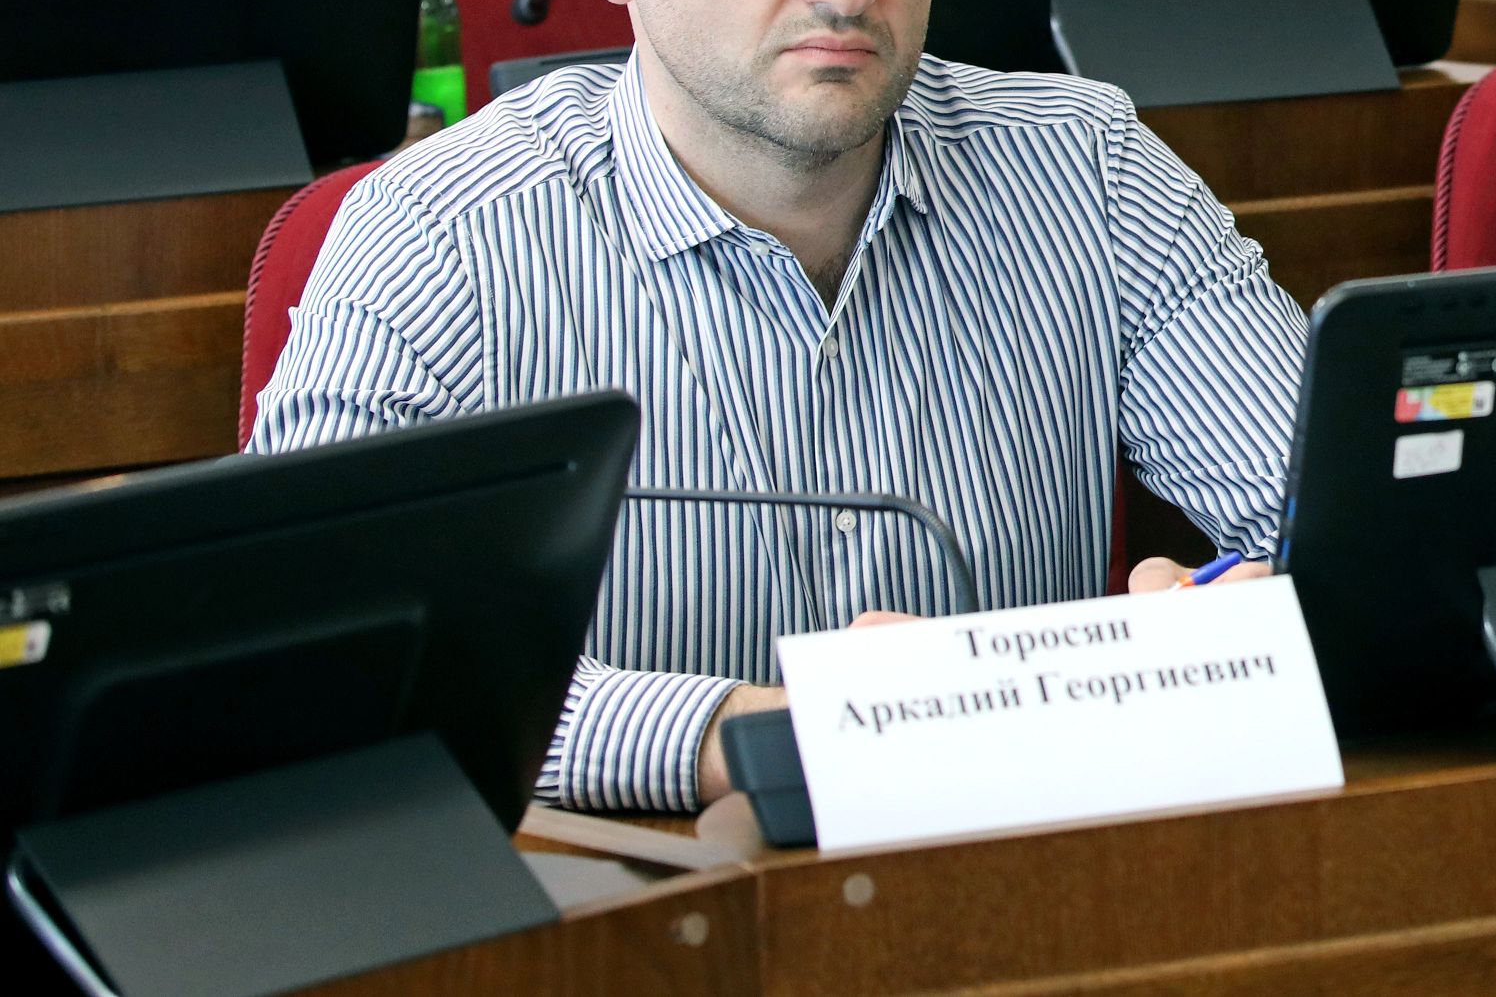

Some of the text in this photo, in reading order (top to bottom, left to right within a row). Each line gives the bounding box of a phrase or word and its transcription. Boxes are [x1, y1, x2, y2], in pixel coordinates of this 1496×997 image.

[957, 618, 1132, 661] Торосян
[838, 654, 1277, 734] Аркадий Георгиевич
